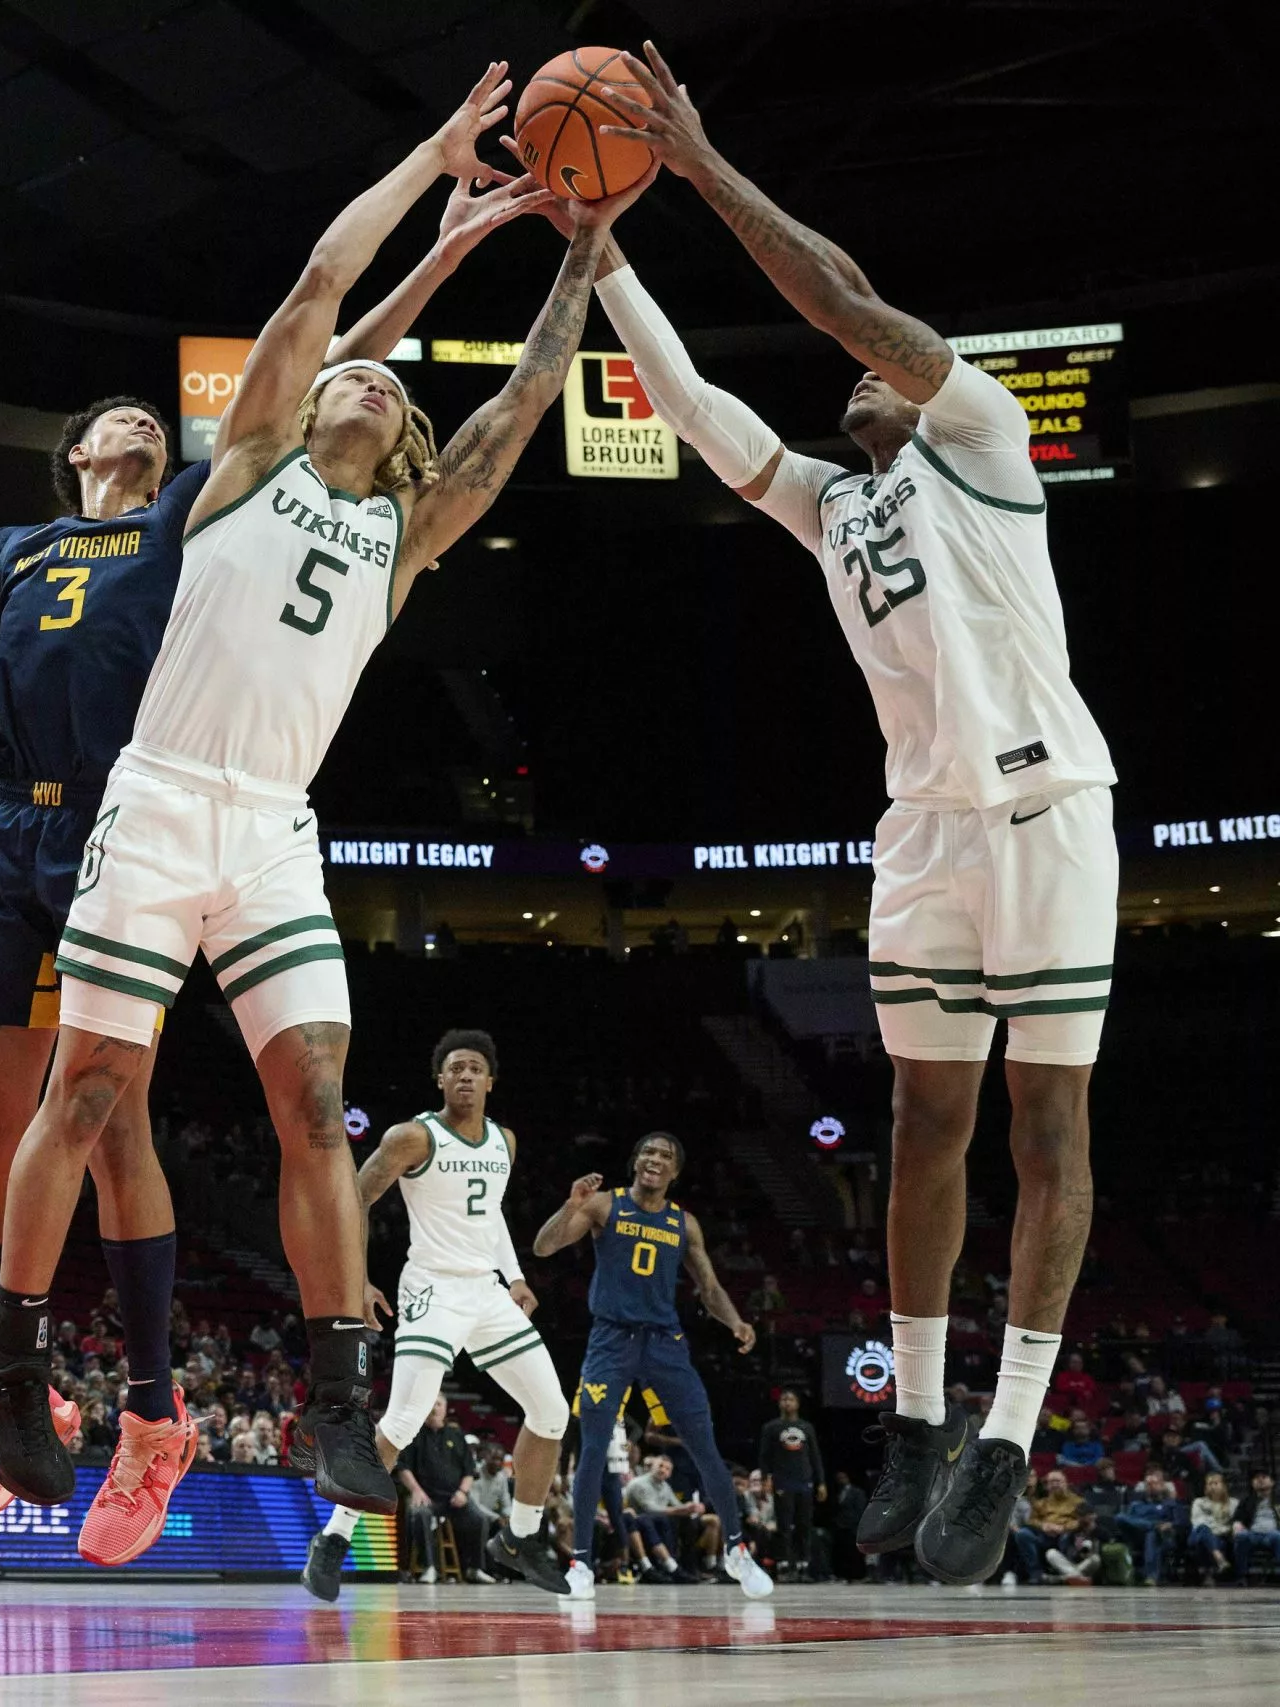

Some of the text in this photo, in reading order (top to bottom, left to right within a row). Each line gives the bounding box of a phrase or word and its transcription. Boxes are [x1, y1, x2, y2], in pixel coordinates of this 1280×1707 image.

[956, 326, 1110, 351] HUSTLEBOARD
[972, 348, 1116, 371] AZERS GUEST
[997, 368, 1091, 390] OCKED SHOTS
[1018, 391, 1087, 412] OUNDS
[581, 427, 663, 445] LORENTZ
[1030, 415, 1083, 435] EALS
[583, 445, 664, 464] BRUUN
[1030, 443, 1077, 462] OTAL
[271, 488, 391, 569] VIKINGS
[58, 531, 141, 559] VIRGINIA
[842, 526, 927, 628] 25
[40, 567, 91, 631] 3
[279, 547, 350, 636] 5
[32, 781, 63, 807] WVU
[1153, 820, 1213, 848] PHIL
[329, 841, 494, 868] KNIGHT LEGACY
[694, 845, 749, 870] PHIL
[754, 841, 840, 867] KNIGHT
[438, 1160, 508, 1174] VIKINGS
[466, 1178, 487, 1216] 2
[615, 1220, 641, 1236] WEST
[631, 1241, 657, 1277] 0
